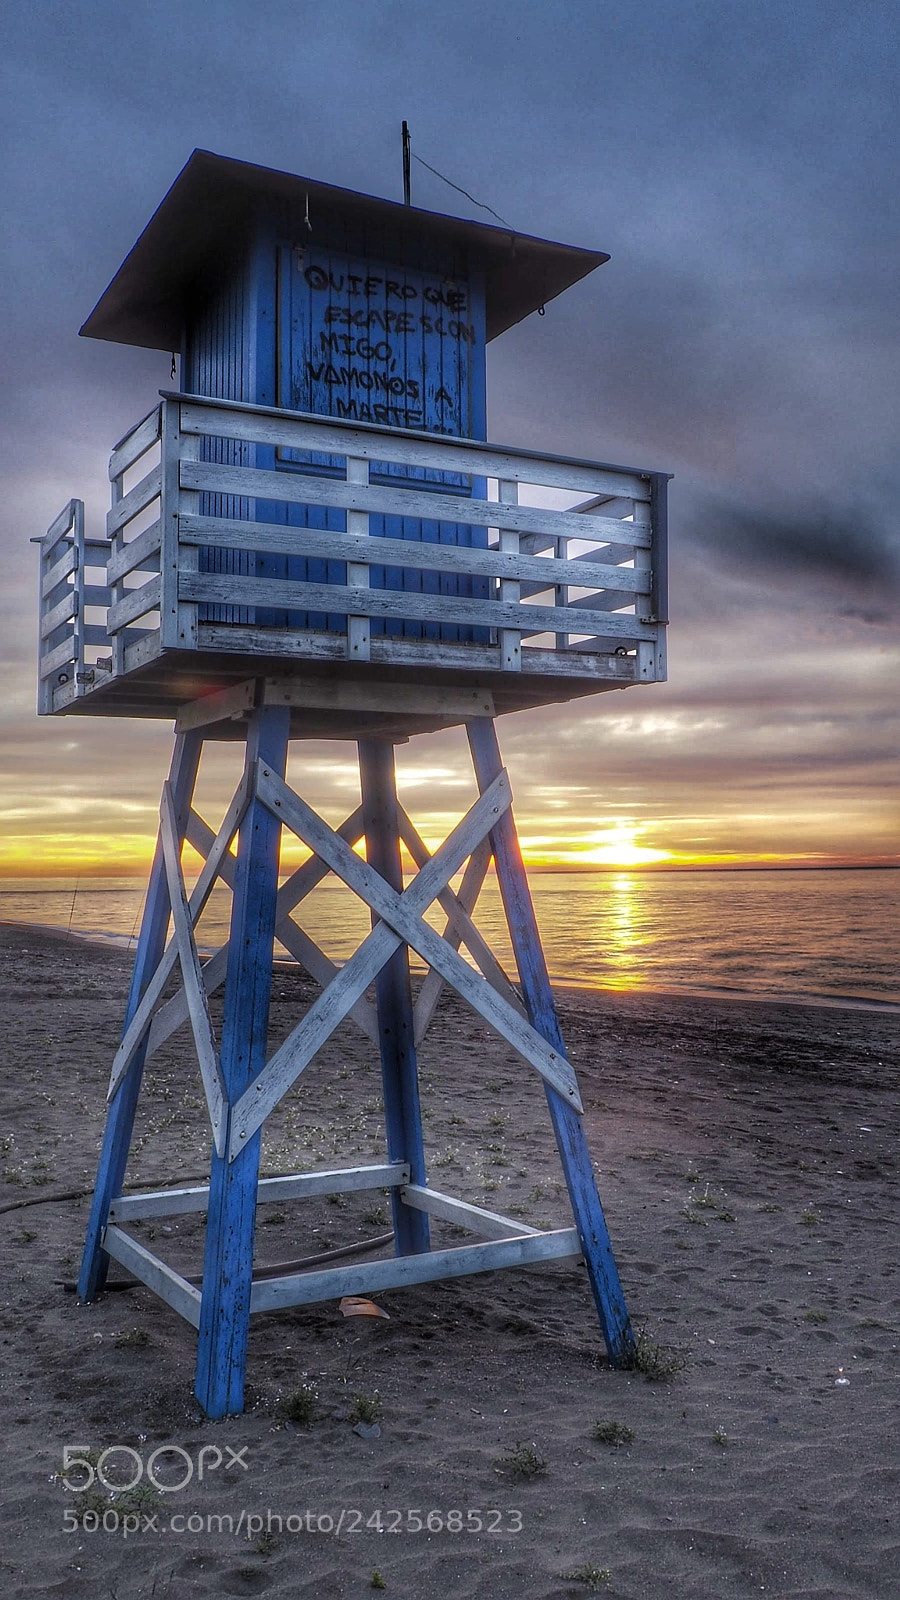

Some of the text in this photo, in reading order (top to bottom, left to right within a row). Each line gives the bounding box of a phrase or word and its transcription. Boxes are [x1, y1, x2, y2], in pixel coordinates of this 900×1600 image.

[304, 265, 467, 314] QUIERO QUE
[306, 362, 453, 407] VAMONOS A
